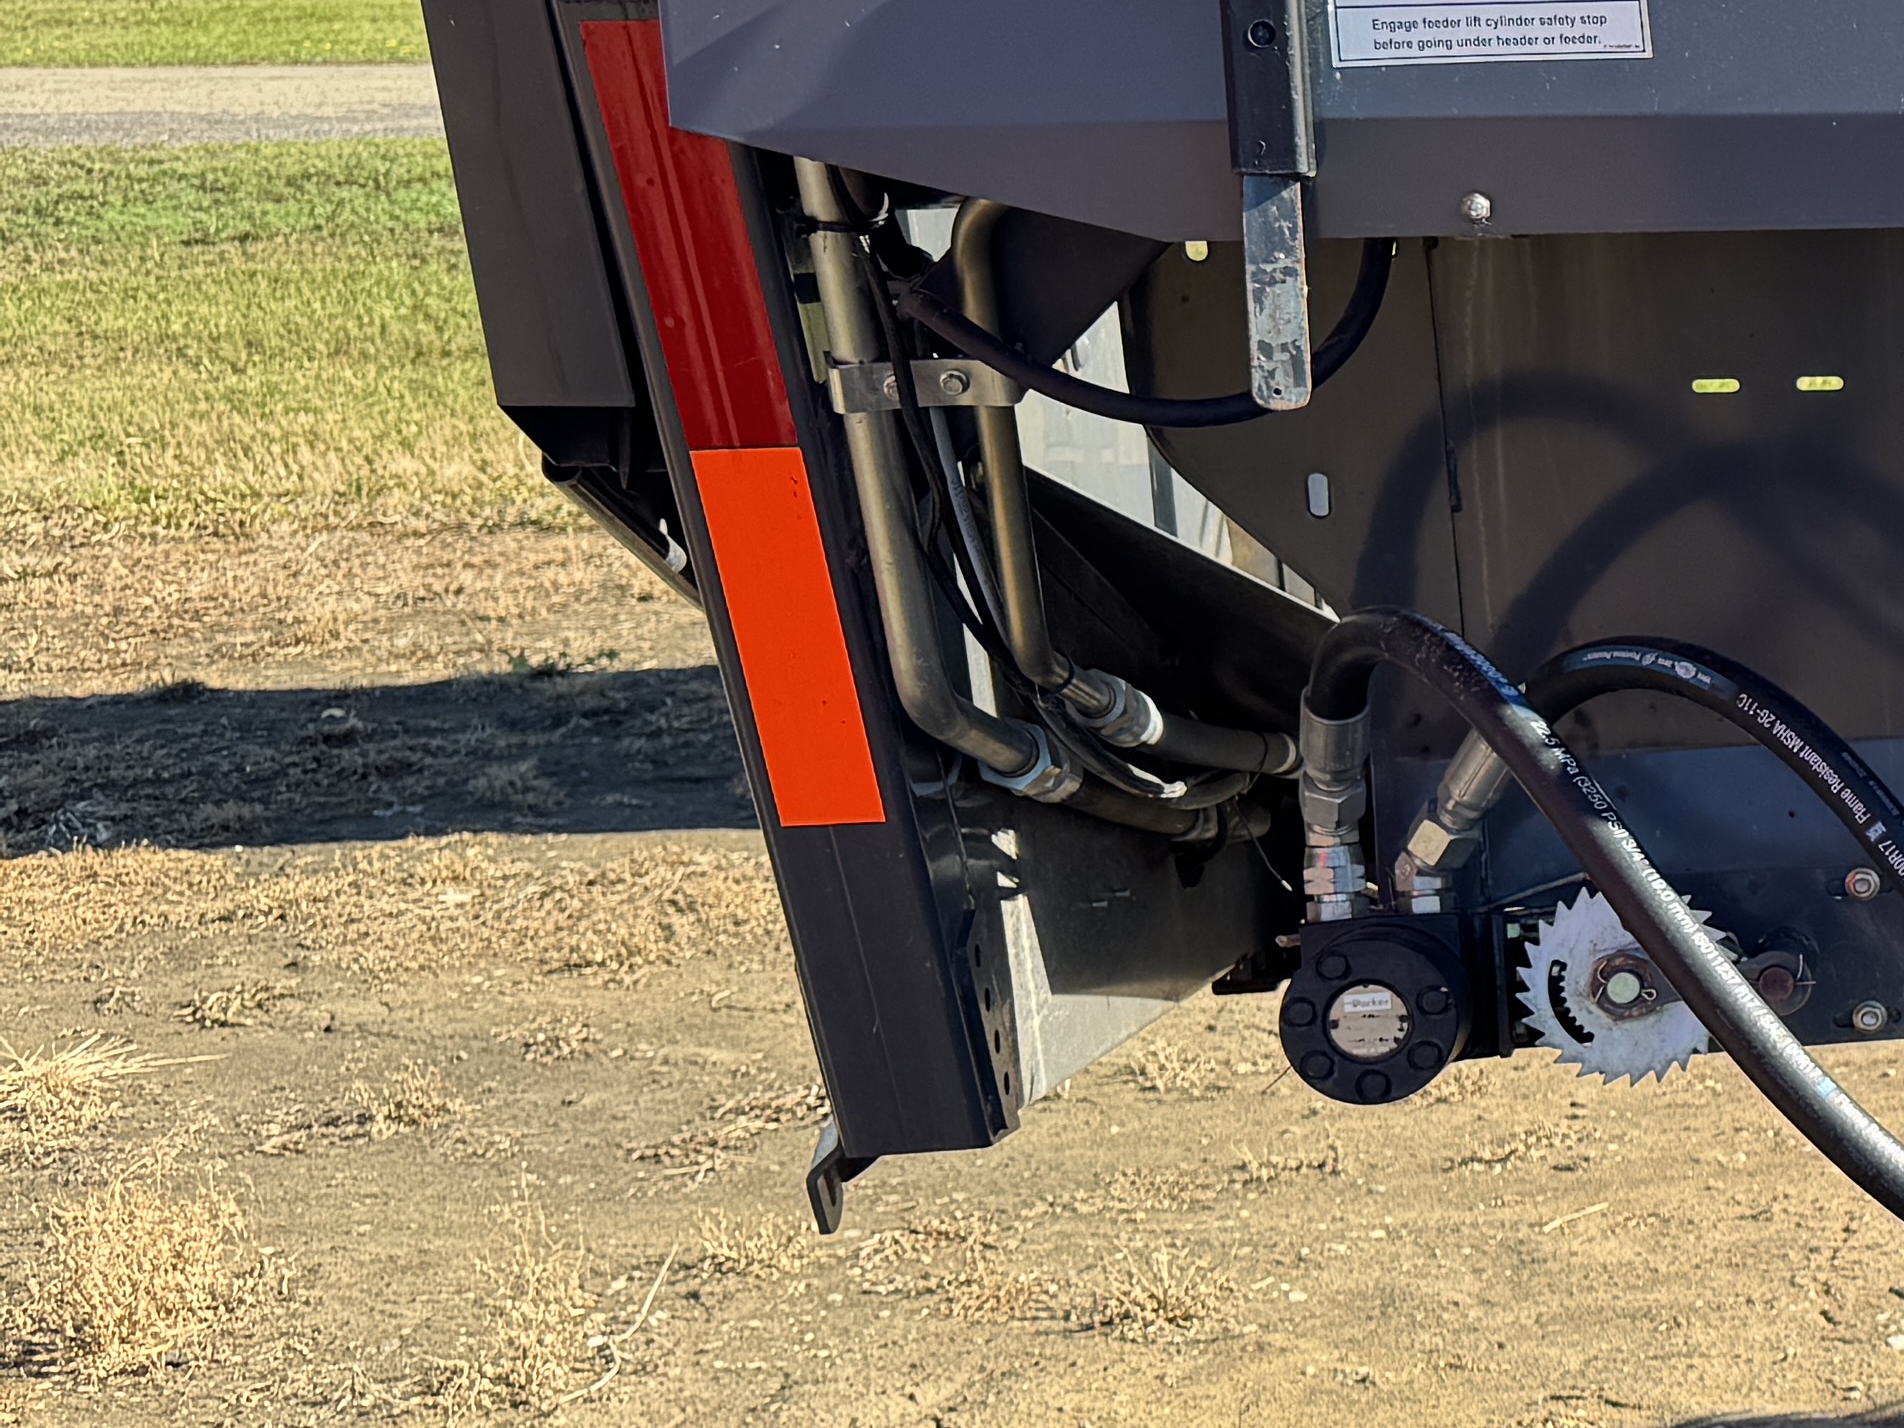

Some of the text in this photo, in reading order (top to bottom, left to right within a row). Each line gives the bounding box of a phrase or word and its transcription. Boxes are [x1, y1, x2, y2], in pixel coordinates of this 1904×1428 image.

[1371, 14, 1607, 33] Engage feeder lift cylinder safety stop
[1373, 38, 1413, 52] before
[1417, 36, 1453, 51] going
[1456, 35, 1492, 48] under
[1496, 34, 1539, 47] header
[1543, 36, 1555, 46] or
[1559, 33, 1602, 46] feeder.
[1736, 693, 1777, 728] 2G-11C
[1772, 720, 1805, 754] MSHA
[1799, 745, 1845, 795] Resistant
[1554, 747, 1580, 776] MPa
[1572, 775, 1608, 811] (3250
[1602, 812, 1629, 839] PSI)
[1840, 789, 1872, 824] Flame
